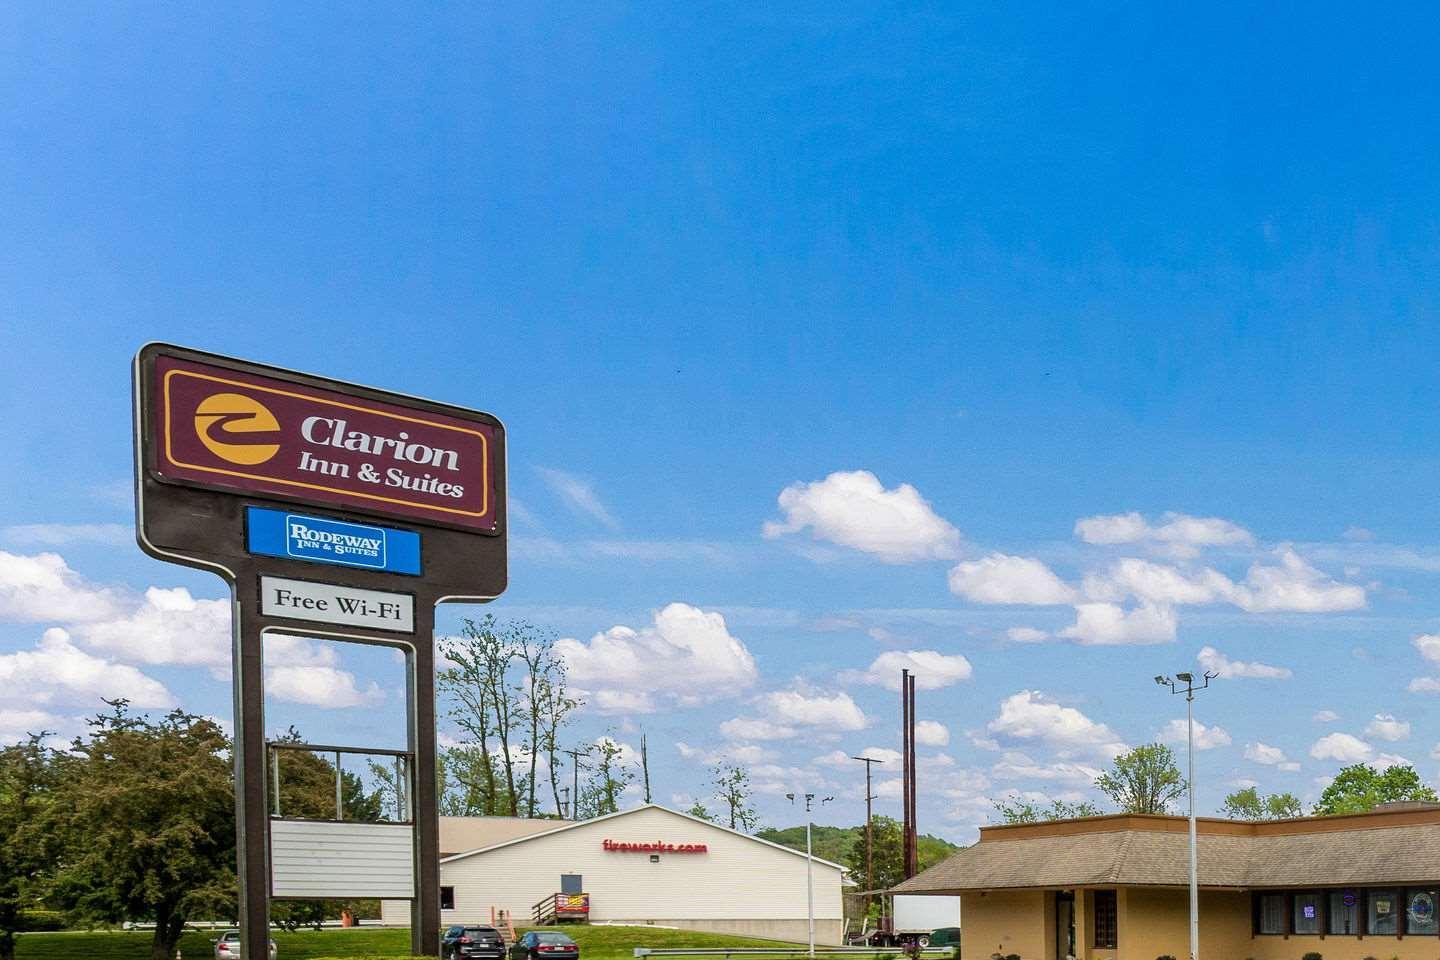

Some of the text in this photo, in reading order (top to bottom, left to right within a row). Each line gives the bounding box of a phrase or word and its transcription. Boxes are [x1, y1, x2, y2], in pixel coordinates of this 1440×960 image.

[301, 416, 460, 471] Clarion
[297, 451, 464, 498] Inn & Suites
[290, 523, 382, 550] RODEWAY
[297, 539, 378, 557] INN & SUITES
[274, 589, 403, 620] Free Wi-Fi
[602, 839, 708, 853] fireworks.com
